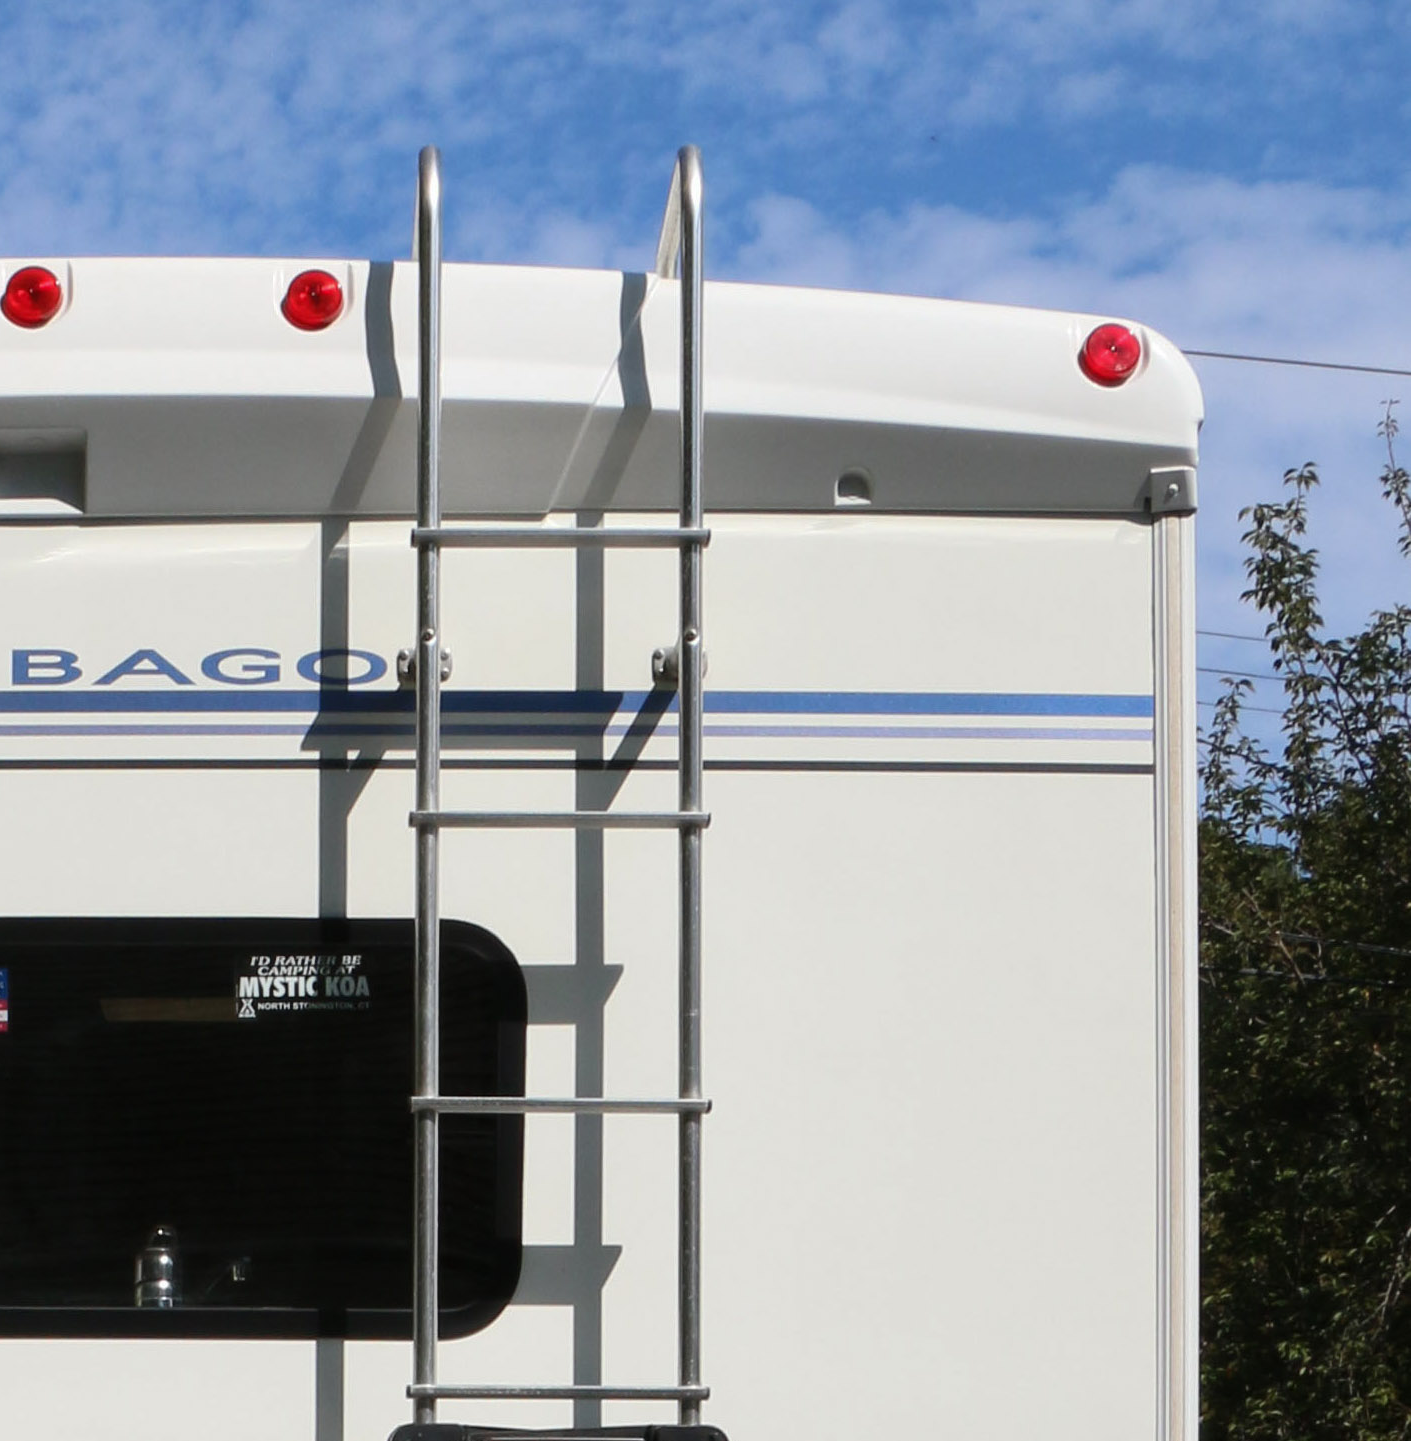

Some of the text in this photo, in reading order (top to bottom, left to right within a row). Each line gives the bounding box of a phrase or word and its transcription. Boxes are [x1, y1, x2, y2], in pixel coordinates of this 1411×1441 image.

[250, 955, 362, 966] I'D RATHER BE
[257, 965, 355, 976] CAMPING AT
[239, 975, 370, 997] MYSTIC KOA
[257, 1002, 291, 1010] NORTH
